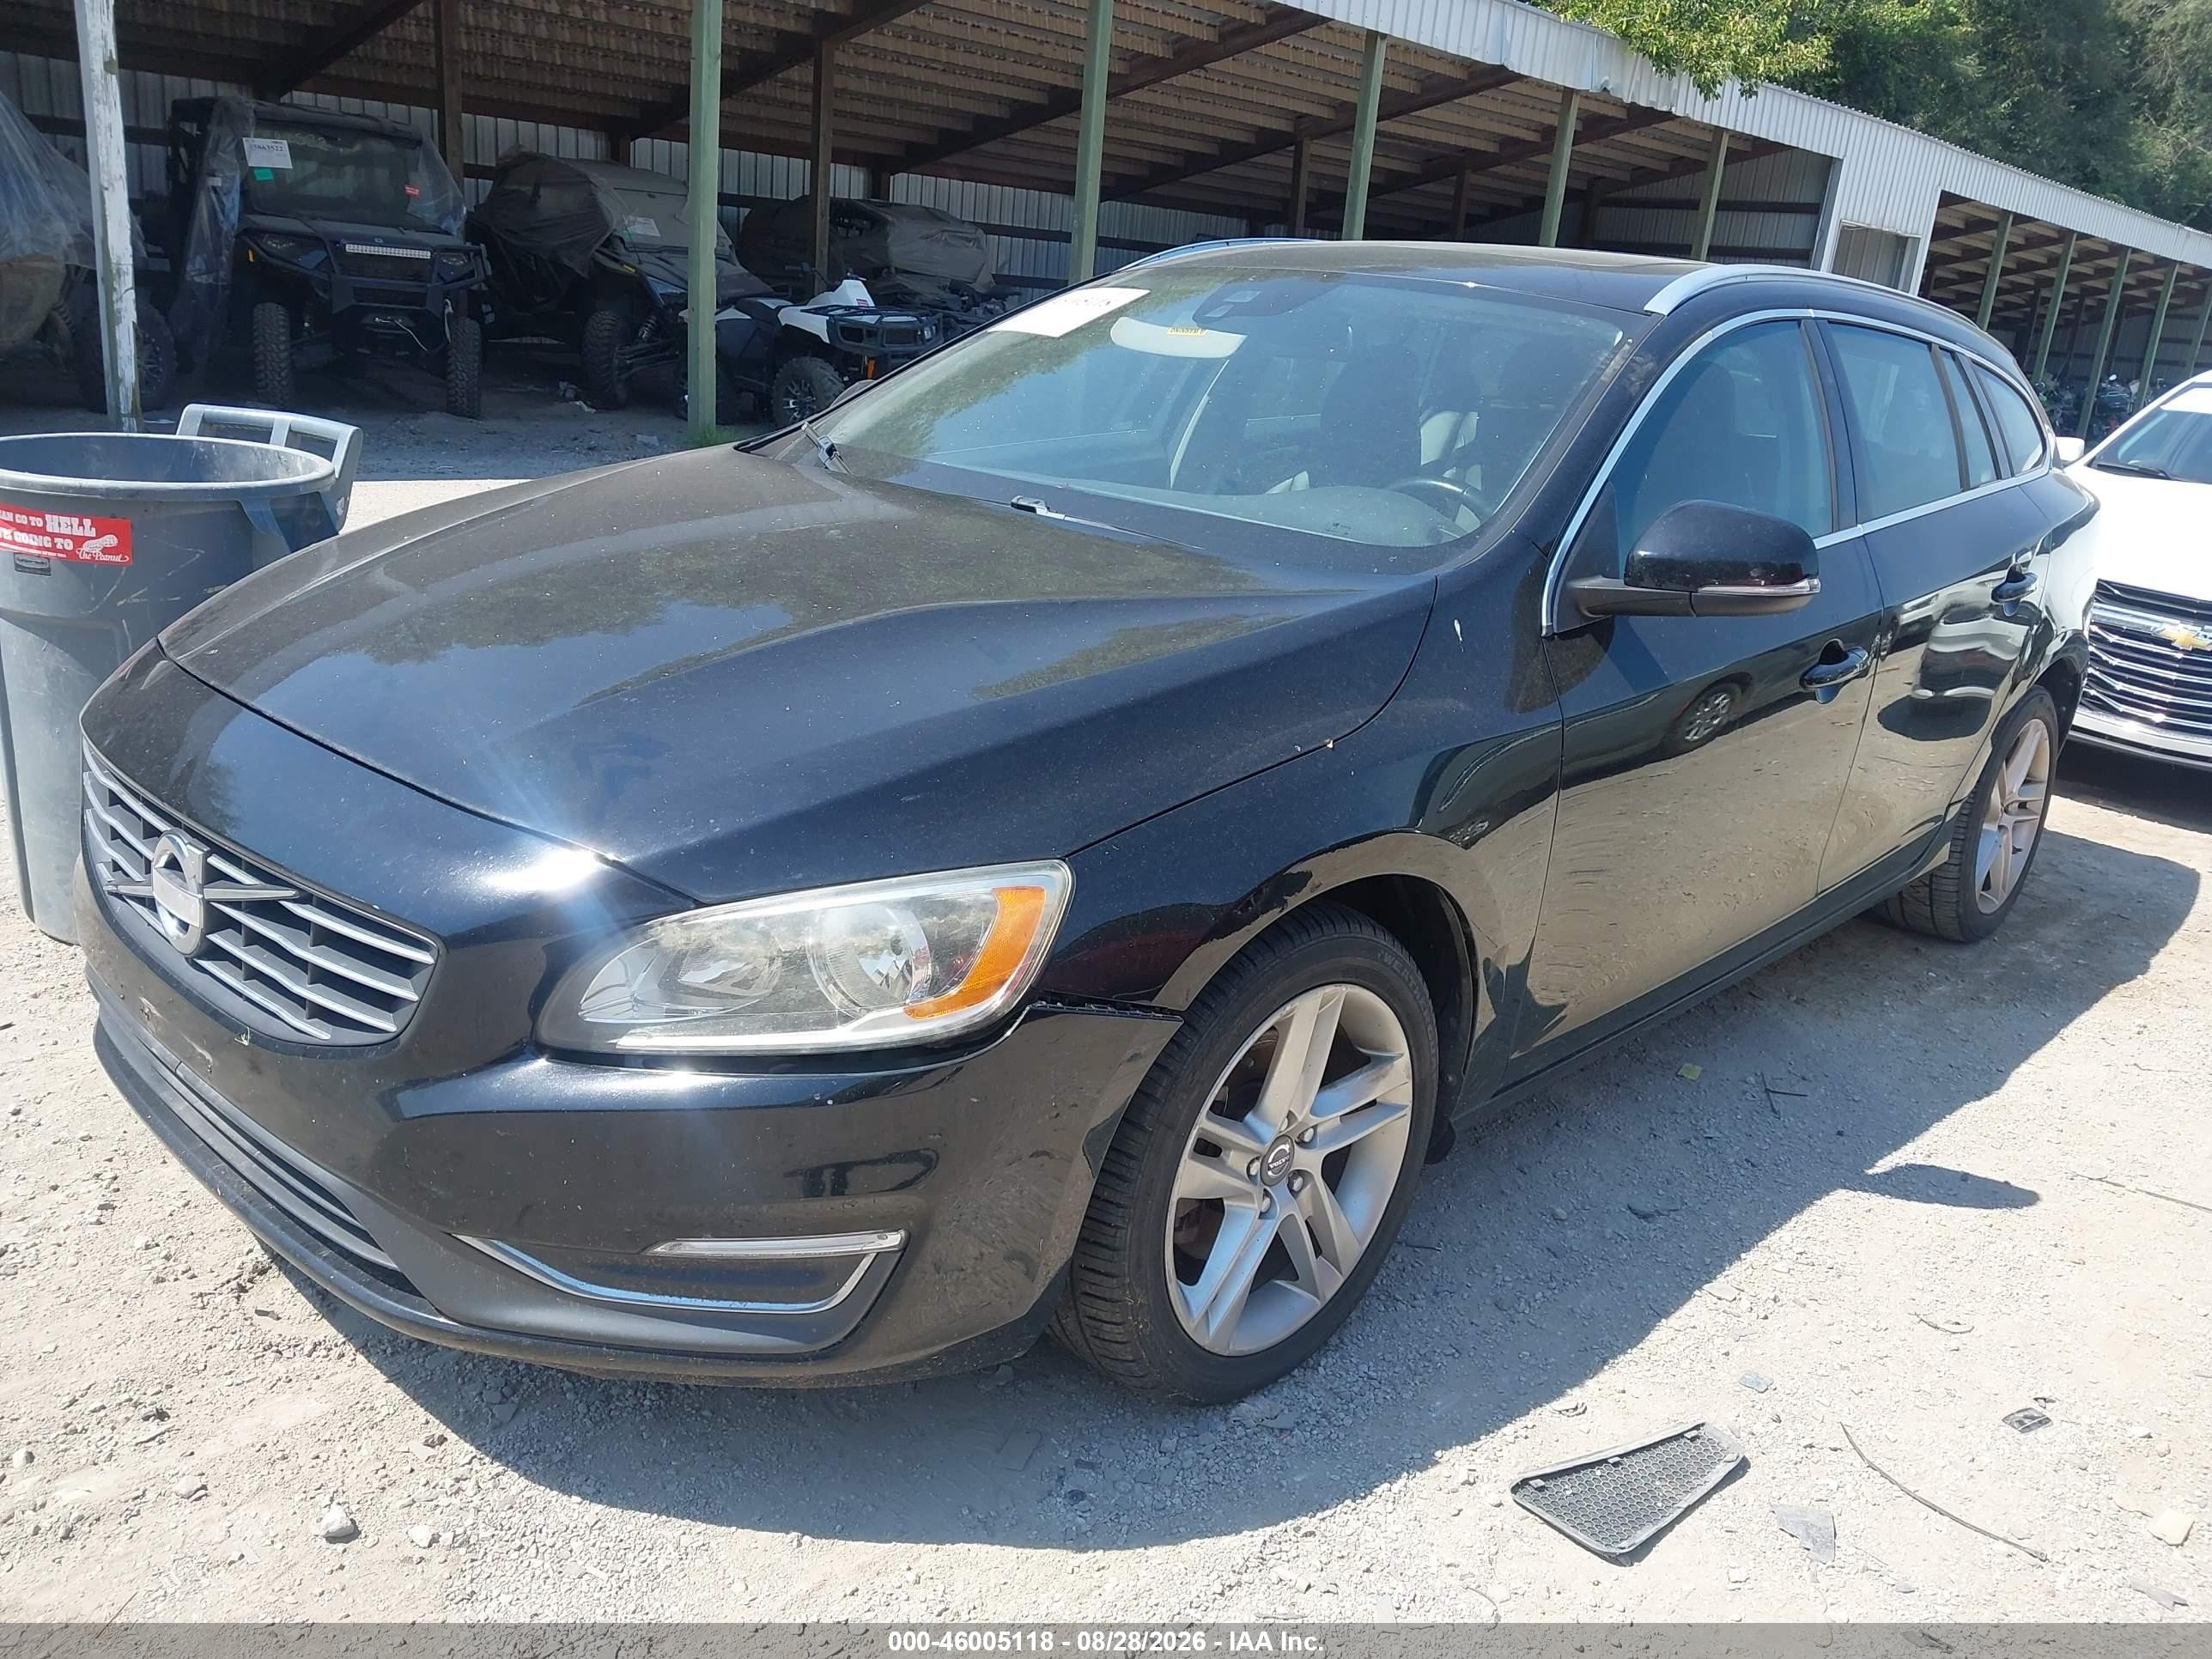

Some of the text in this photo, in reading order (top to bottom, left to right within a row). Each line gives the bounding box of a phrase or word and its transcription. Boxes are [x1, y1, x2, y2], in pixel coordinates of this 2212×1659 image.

[15, 514, 27, 526] GO
[28, 516, 44, 528] TO
[45, 514, 96, 538] HELL
[14, 531, 52, 549] GOING
[54, 537, 74, 550] TO
[76, 547, 92, 560] The
[93, 550, 130, 562] Peanut
[1268, 1155, 1290, 1169] VOLVO
